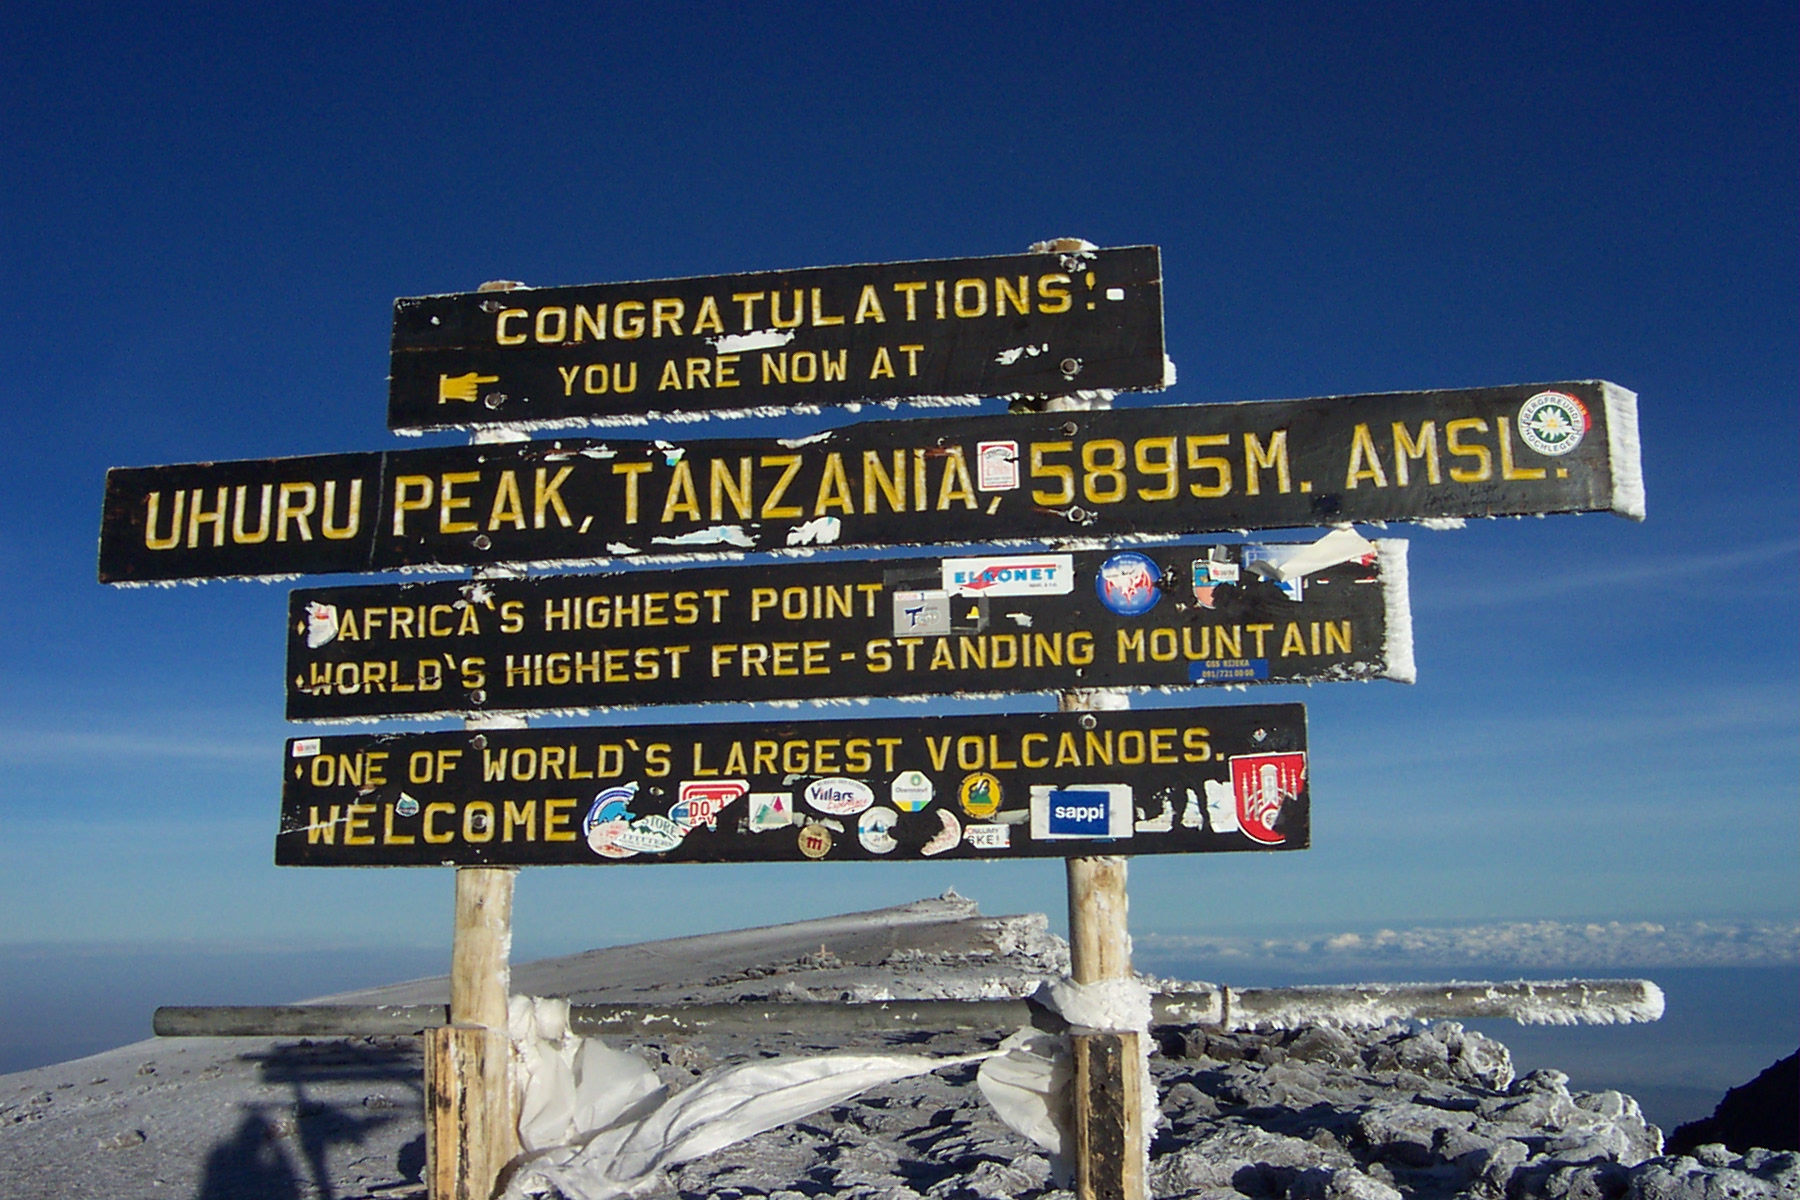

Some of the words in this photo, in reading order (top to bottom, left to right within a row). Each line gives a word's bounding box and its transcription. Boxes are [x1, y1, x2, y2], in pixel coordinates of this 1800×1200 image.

[497, 272, 1096, 347] CONGRATULATIONS!
[558, 361, 638, 396] YOU
[658, 355, 741, 391] ARE
[762, 349, 848, 385] NOW
[870, 344, 925, 379] AT
[145, 478, 362, 550] UHURU
[393, 466, 594, 536] PEAK,
[612, 445, 1002, 525] TANZANIA,
[1030, 430, 1312, 506] 5895M.
[1345, 416, 1569, 490] AMSL.
[954, 568, 1057, 584] ELKONET
[545, 589, 730, 632] HIGHEST
[751, 583, 883, 622] POINT
[505, 645, 690, 687] HIGHEST
[711, 630, 1095, 678] FREE-STANDING
[1116, 620, 1352, 664] MOUNTAIN
[311, 752, 389, 787] ONE
[409, 750, 463, 784] OF
[693, 738, 903, 777] LARGEST
[925, 727, 1225, 772] VOLCANOES.
[810, 787, 855, 803] Villars
[1055, 803, 1105, 822] sappi
[305, 798, 578, 846] WELCOME
